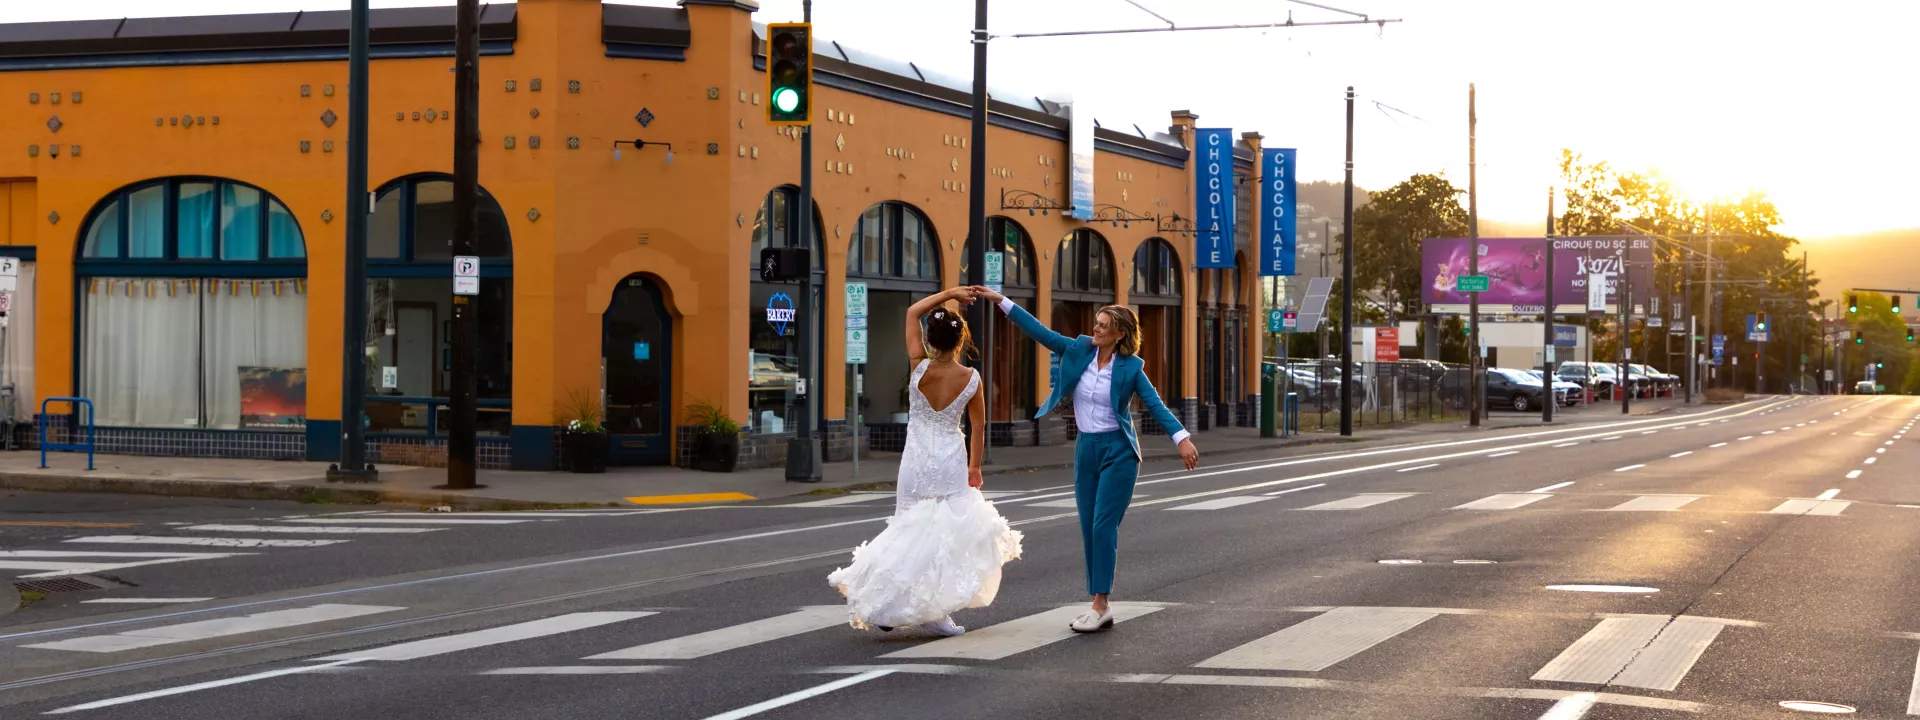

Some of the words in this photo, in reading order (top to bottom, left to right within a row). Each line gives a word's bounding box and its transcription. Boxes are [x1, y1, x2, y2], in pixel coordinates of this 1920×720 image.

[1209, 133, 1220, 263] CHOCOLATE
[1273, 153, 1284, 271] CHOCOLATE
[1595, 240, 1610, 249] DU
[766, 308, 796, 321] BAKERY
[1273, 320, 1279, 328] 2
